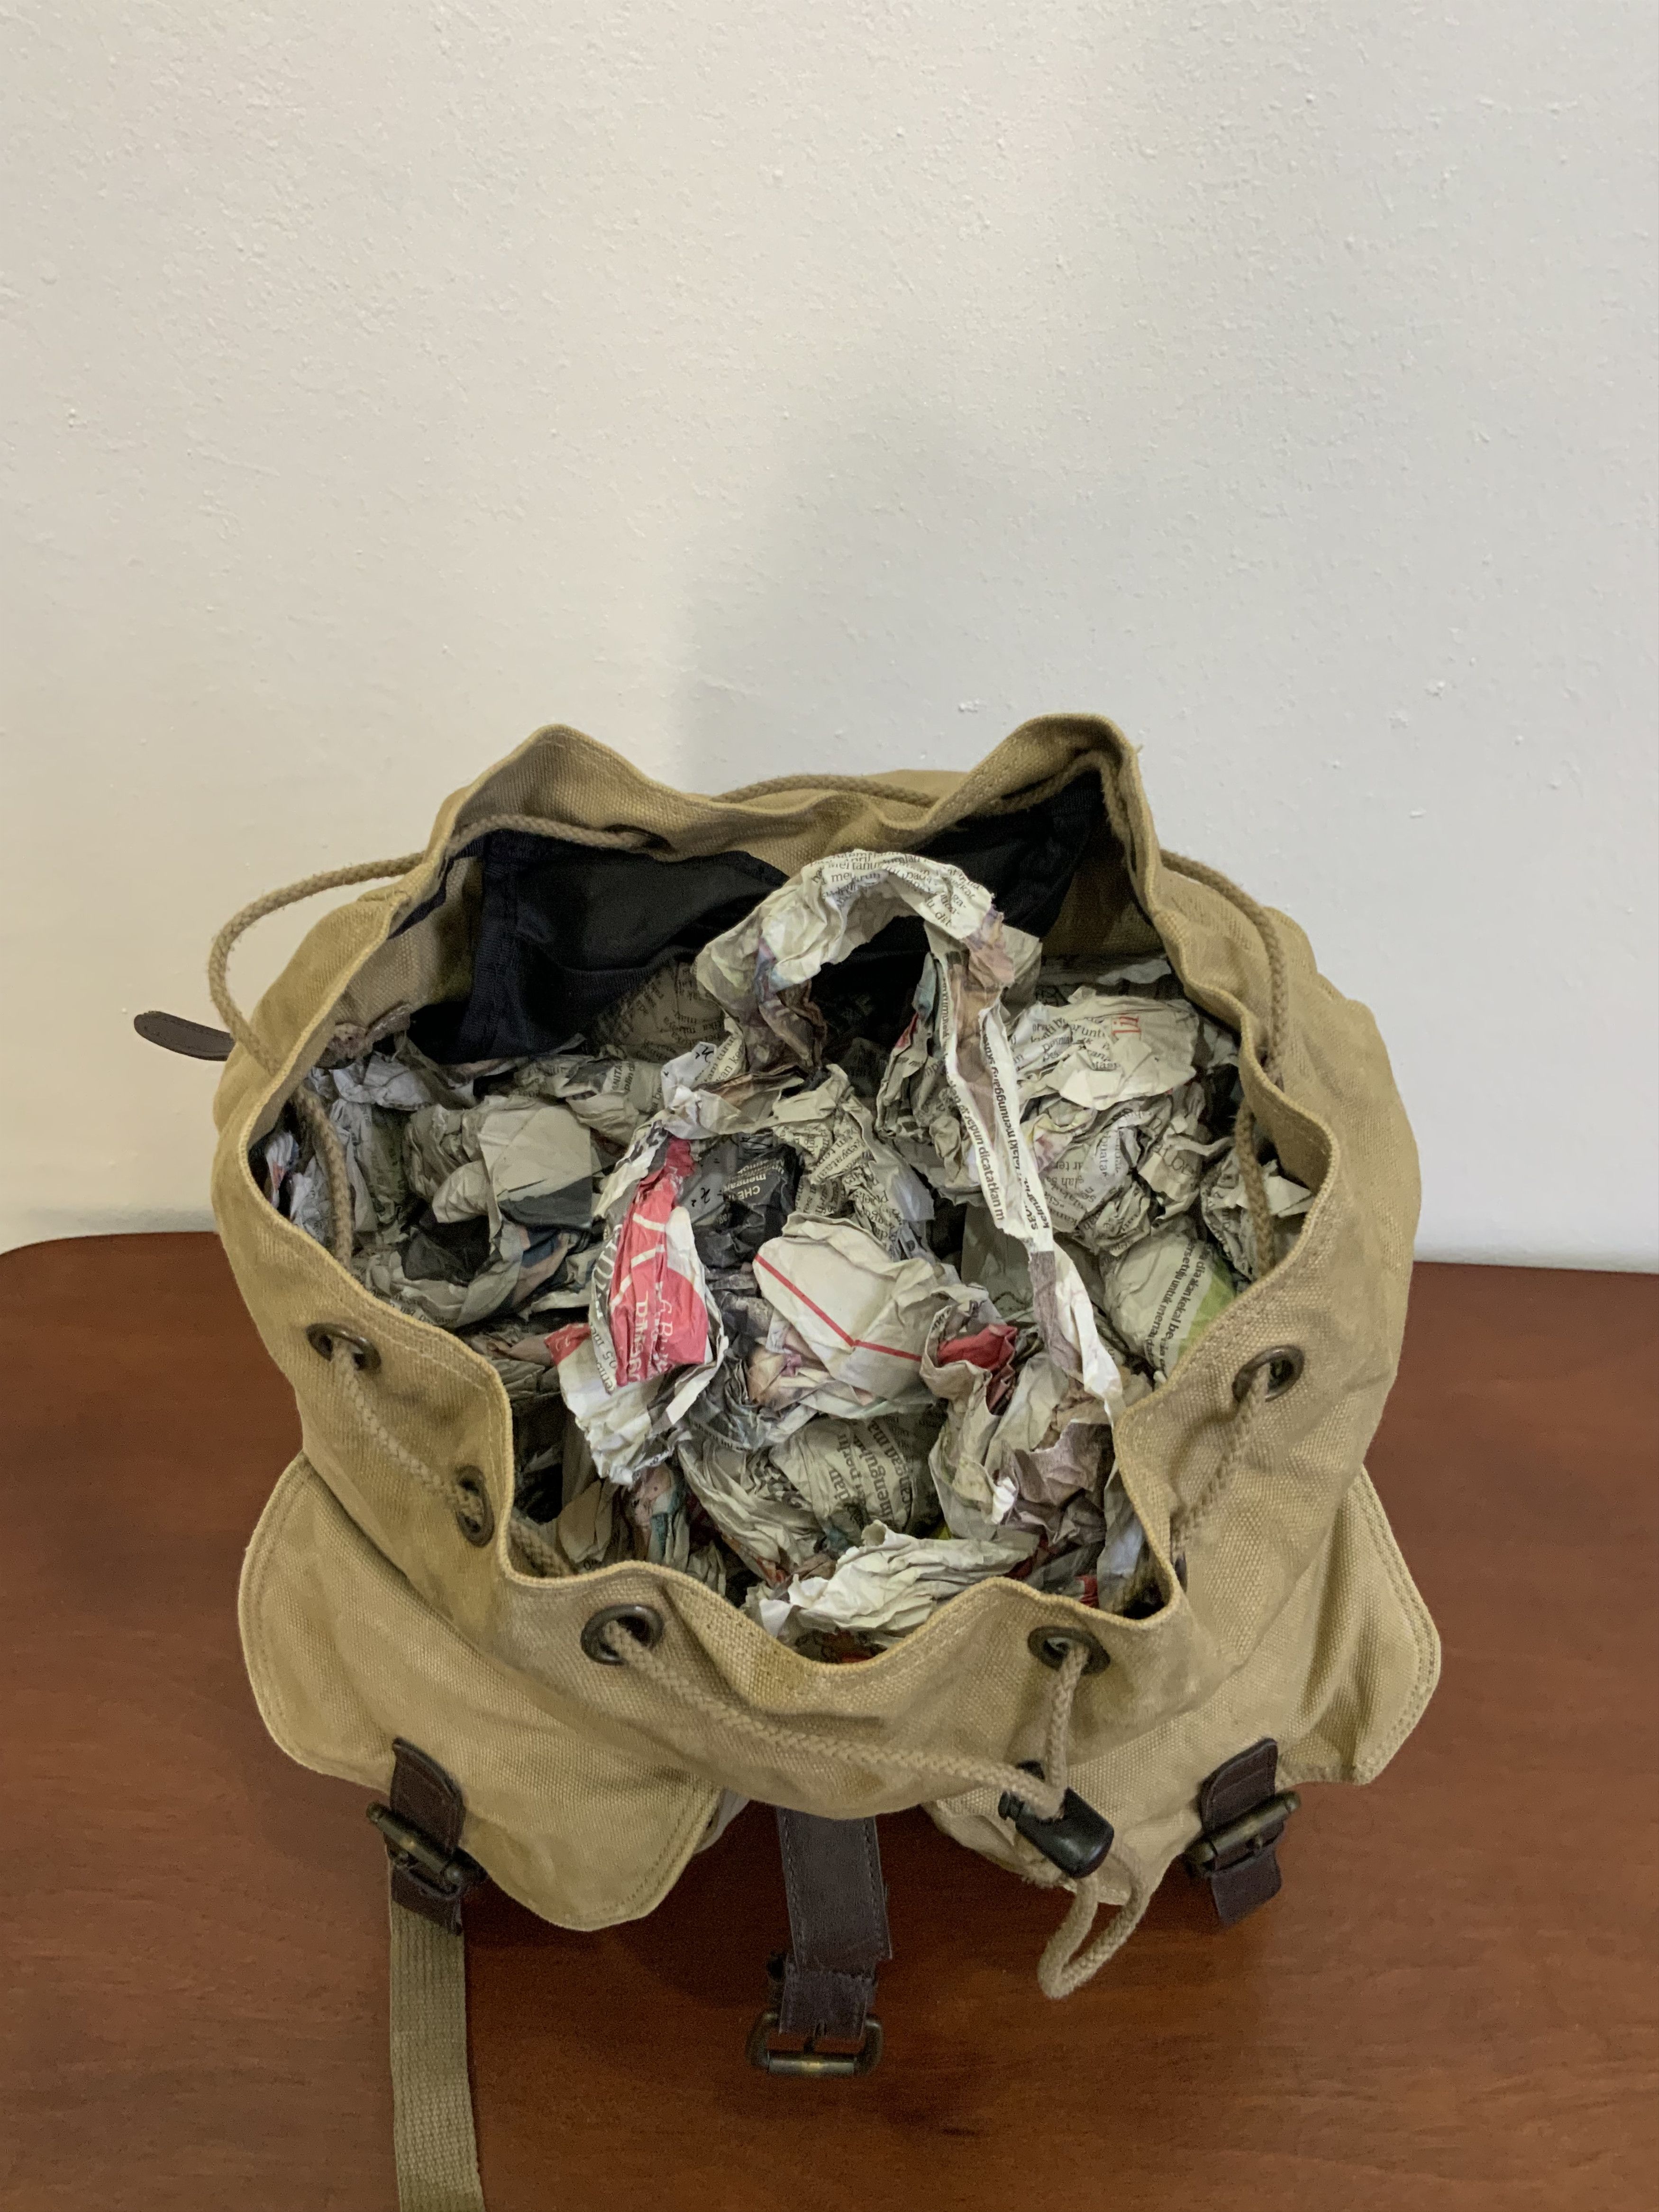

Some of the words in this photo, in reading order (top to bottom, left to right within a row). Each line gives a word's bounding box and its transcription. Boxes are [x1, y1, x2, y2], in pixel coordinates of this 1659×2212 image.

[978, 1146, 1003, 1207] dicatatkan
[1175, 1240, 1196, 1281] ersetuju
[1161, 1280, 1181, 1304] untuk
[1171, 1295, 1192, 1324] kekal
[829, 1469, 851, 1503] dan
